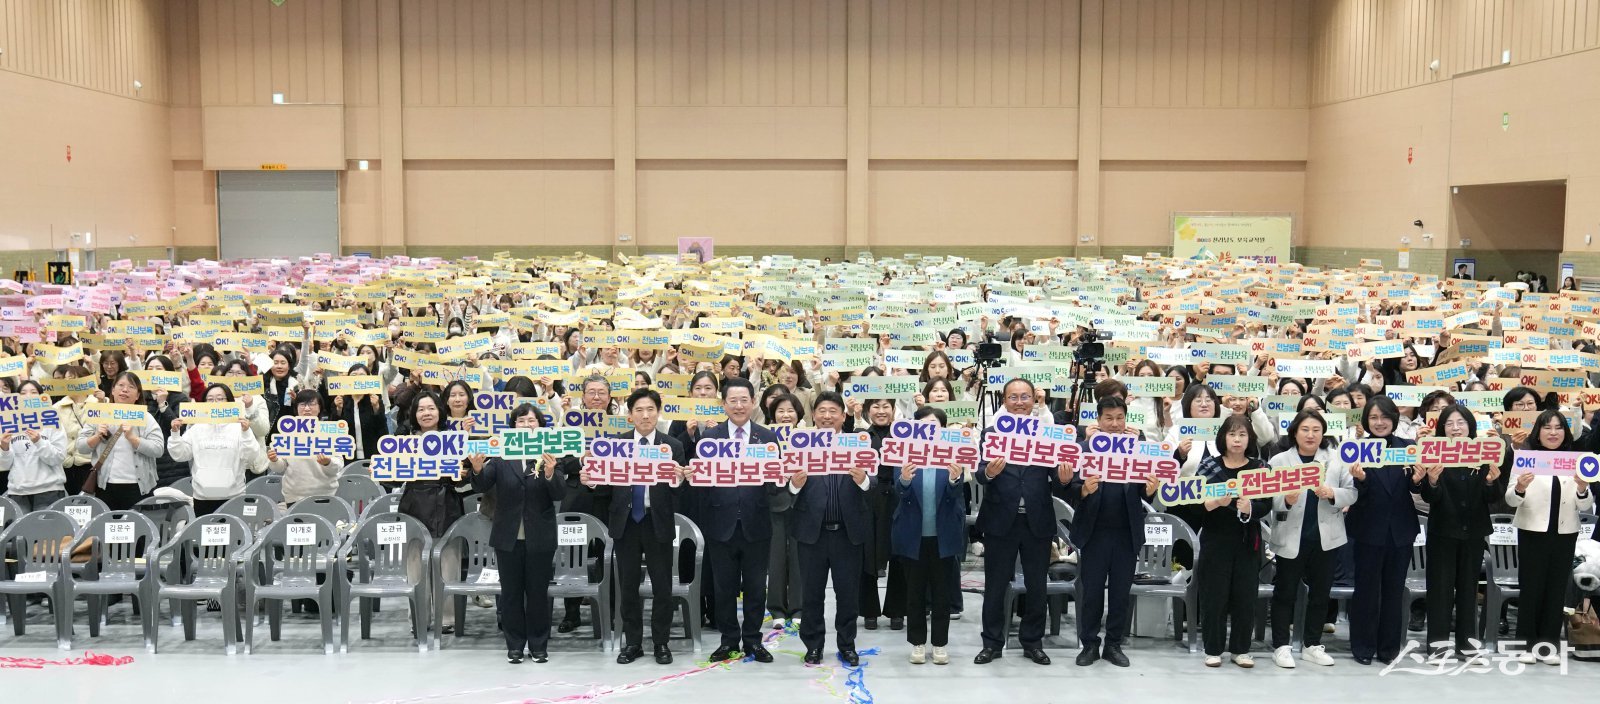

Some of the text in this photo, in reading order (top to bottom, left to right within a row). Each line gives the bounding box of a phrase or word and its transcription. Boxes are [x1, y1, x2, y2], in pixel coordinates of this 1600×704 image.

[1248, 310, 1260, 318] OK!
[1316, 308, 1328, 316] OK!
[1186, 316, 1237, 326] OK! 전남보육
[1391, 319, 1443, 329] OK! 전남보육
[126, 326, 154, 334] 전남보육
[1526, 322, 1574, 336] OK! 전남보육
[242, 338, 267, 348] 전남보육
[642, 335, 669, 344] 전남보육
[693, 334, 705, 343] OK!
[1304, 338, 1316, 347] OK!
[1504, 335, 1517, 344] OK!
[438, 345, 452, 354] OK!
[464, 337, 489, 350] 전남보육
[535, 346, 559, 354] 전남보육
[826, 343, 874, 352] OK! 전남보육
[1252, 342, 1300, 352] OK! 전남보육
[1458, 344, 1487, 354] 전남보육
[394, 354, 406, 362] OK!
[886, 355, 898, 363] OK!
[1048, 350, 1074, 360] 전남보육
[1191, 349, 1248, 360] OK! 전남보육
[1550, 354, 1580, 364] 전남보육
[823, 358, 871, 368] OK! 전남보육
[1277, 364, 1291, 372] OK!
[424, 370, 438, 379] OK!
[504, 365, 559, 376] OK! 전남보육
[1435, 365, 1466, 381] 전남보육
[151, 376, 179, 386] 전남보육
[353, 380, 380, 390] 전남보육
[658, 381, 672, 389] OK!
[989, 376, 1004, 384] OK!
[1521, 376, 1584, 388] OK! 전남보육
[67, 382, 96, 392] 전남보육
[234, 381, 262, 392] 전남보육
[852, 382, 916, 394] OK! 전남보육
[1144, 382, 1173, 392] 전남보육
[1208, 381, 1265, 393] OK! 전남보육
[1490, 382, 1502, 391] OK!
[1387, 392, 1402, 400] OK!
[0, 396, 50, 412] K! 지금은
[476, 394, 514, 410] OK!
[1268, 401, 1284, 410] OK!
[210, 408, 240, 418] 전남보육
[665, 404, 680, 412] OK!
[113, 410, 145, 420] 전남보육
[566, 411, 603, 428] OK!
[0, 410, 60, 434] 남보육
[280, 418, 346, 434] OK! 지금은
[470, 412, 554, 436] 전남육
[1504, 418, 1522, 428] OK!
[894, 421, 972, 443] OK! 지금은
[996, 415, 1074, 441] OK! 지금은
[1180, 425, 1197, 435] OK!
[770, 426, 791, 446] K!
[790, 432, 868, 448] OK! 지금은
[272, 436, 354, 458] 전남보육
[380, 438, 419, 458] OK!
[422, 434, 464, 456] OK!
[467, 440, 500, 456] 지금은
[504, 430, 582, 456] 전남보육
[1092, 435, 1170, 458] OK! 지금은
[593, 441, 634, 458] OK!
[639, 446, 670, 459] 지금은
[700, 441, 778, 459] OK! 지금은
[882, 440, 978, 470] 전남보육
[986, 435, 1080, 470] 전남보육
[1340, 440, 1501, 464] OK! 지금은 전남보육
[782, 450, 878, 474] 전남보육
[1516, 457, 1536, 468] OK!
[372, 457, 460, 479] 전남보육
[586, 460, 677, 484] 전남보육
[691, 460, 784, 485] 전남보육
[1082, 454, 1178, 484] 전남보육
[1161, 478, 1202, 501] OK!
[1241, 466, 1320, 497] 전남보육
[109, 524, 131, 532] 김문수
[206, 526, 227, 534] 주철현
[290, 526, 312, 534] 이개호
[381, 525, 402, 534] 노관규
[562, 526, 583, 534] 김태균
[1146, 526, 1168, 535] 김영옥
